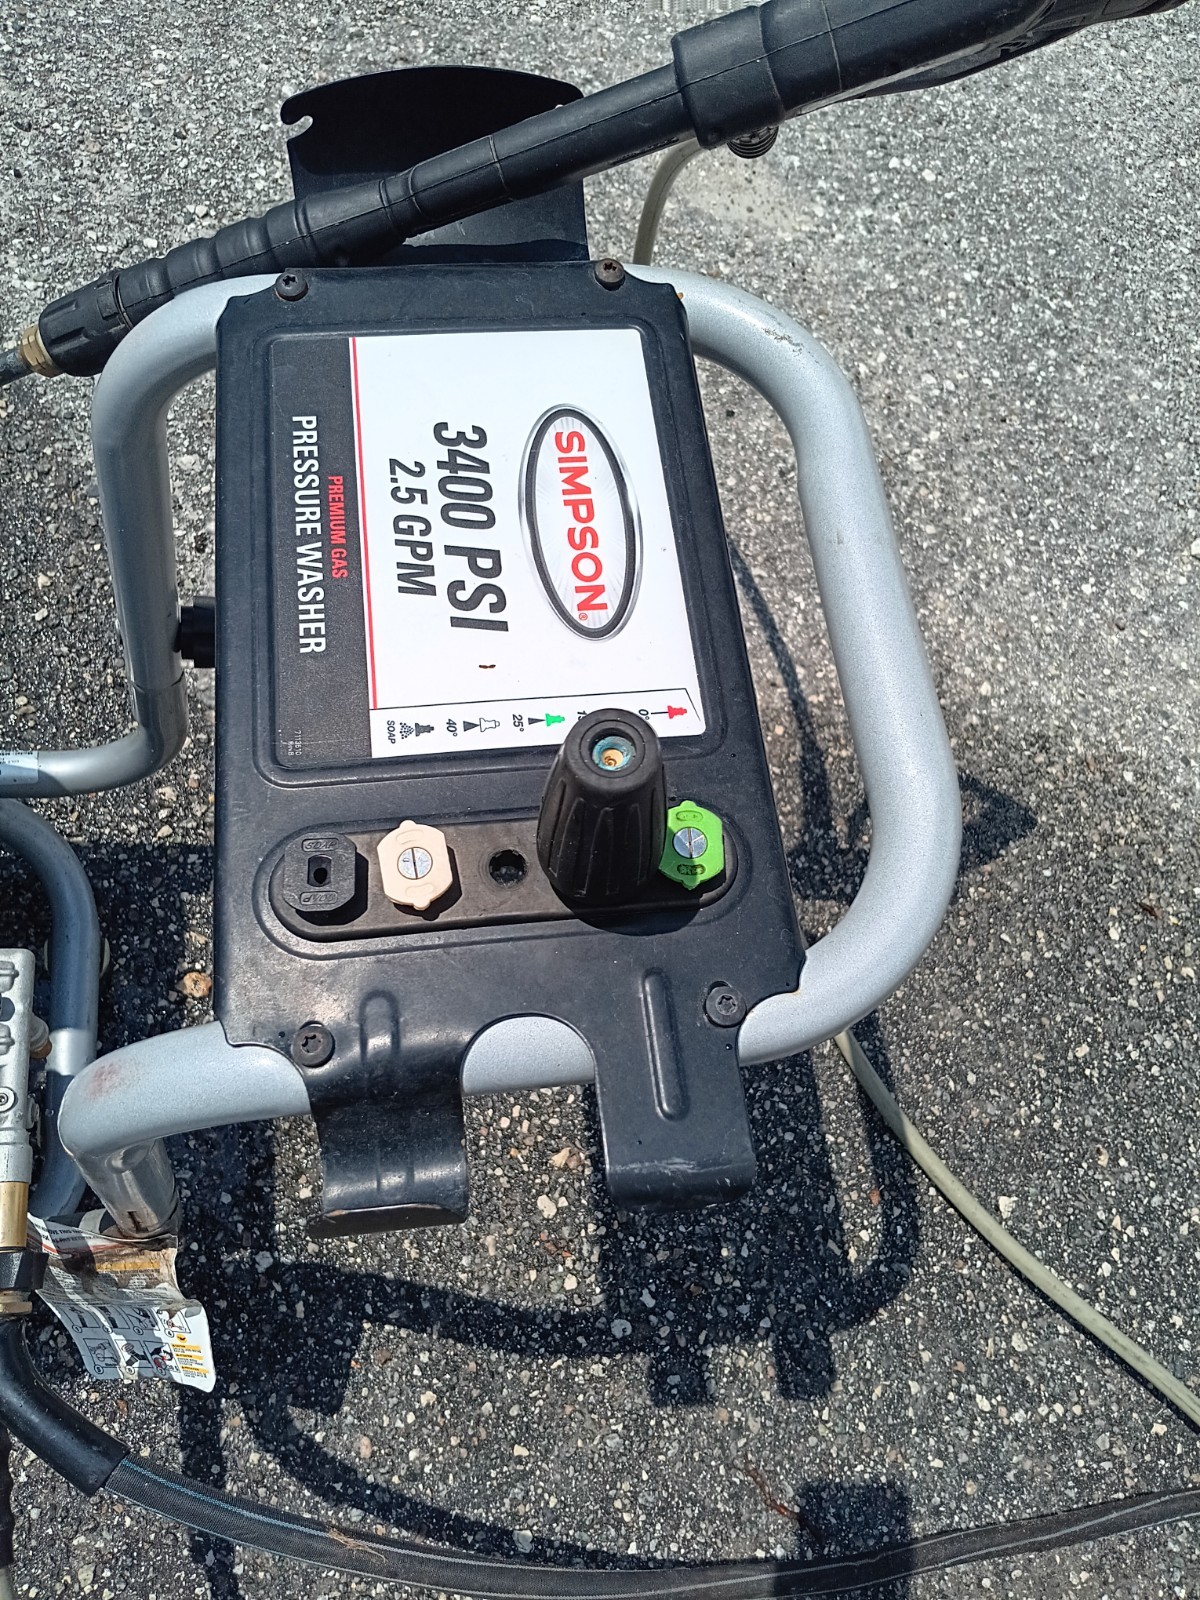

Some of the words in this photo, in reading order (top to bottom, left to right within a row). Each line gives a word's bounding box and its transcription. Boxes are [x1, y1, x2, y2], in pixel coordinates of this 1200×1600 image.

[292, 415, 322, 537] PRESSURE
[328, 475, 347, 545] PREMIUM
[389, 459, 428, 504] 2.5
[433, 422, 496, 529] 3400
[330, 548, 350, 579] GAS
[393, 515, 437, 596] GPM
[444, 545, 509, 631] PSI
[296, 541, 327, 654] WASHER
[386, 719, 396, 744] SOAP
[446, 719, 458, 737] 40°
[512, 714, 525, 732] 25°
